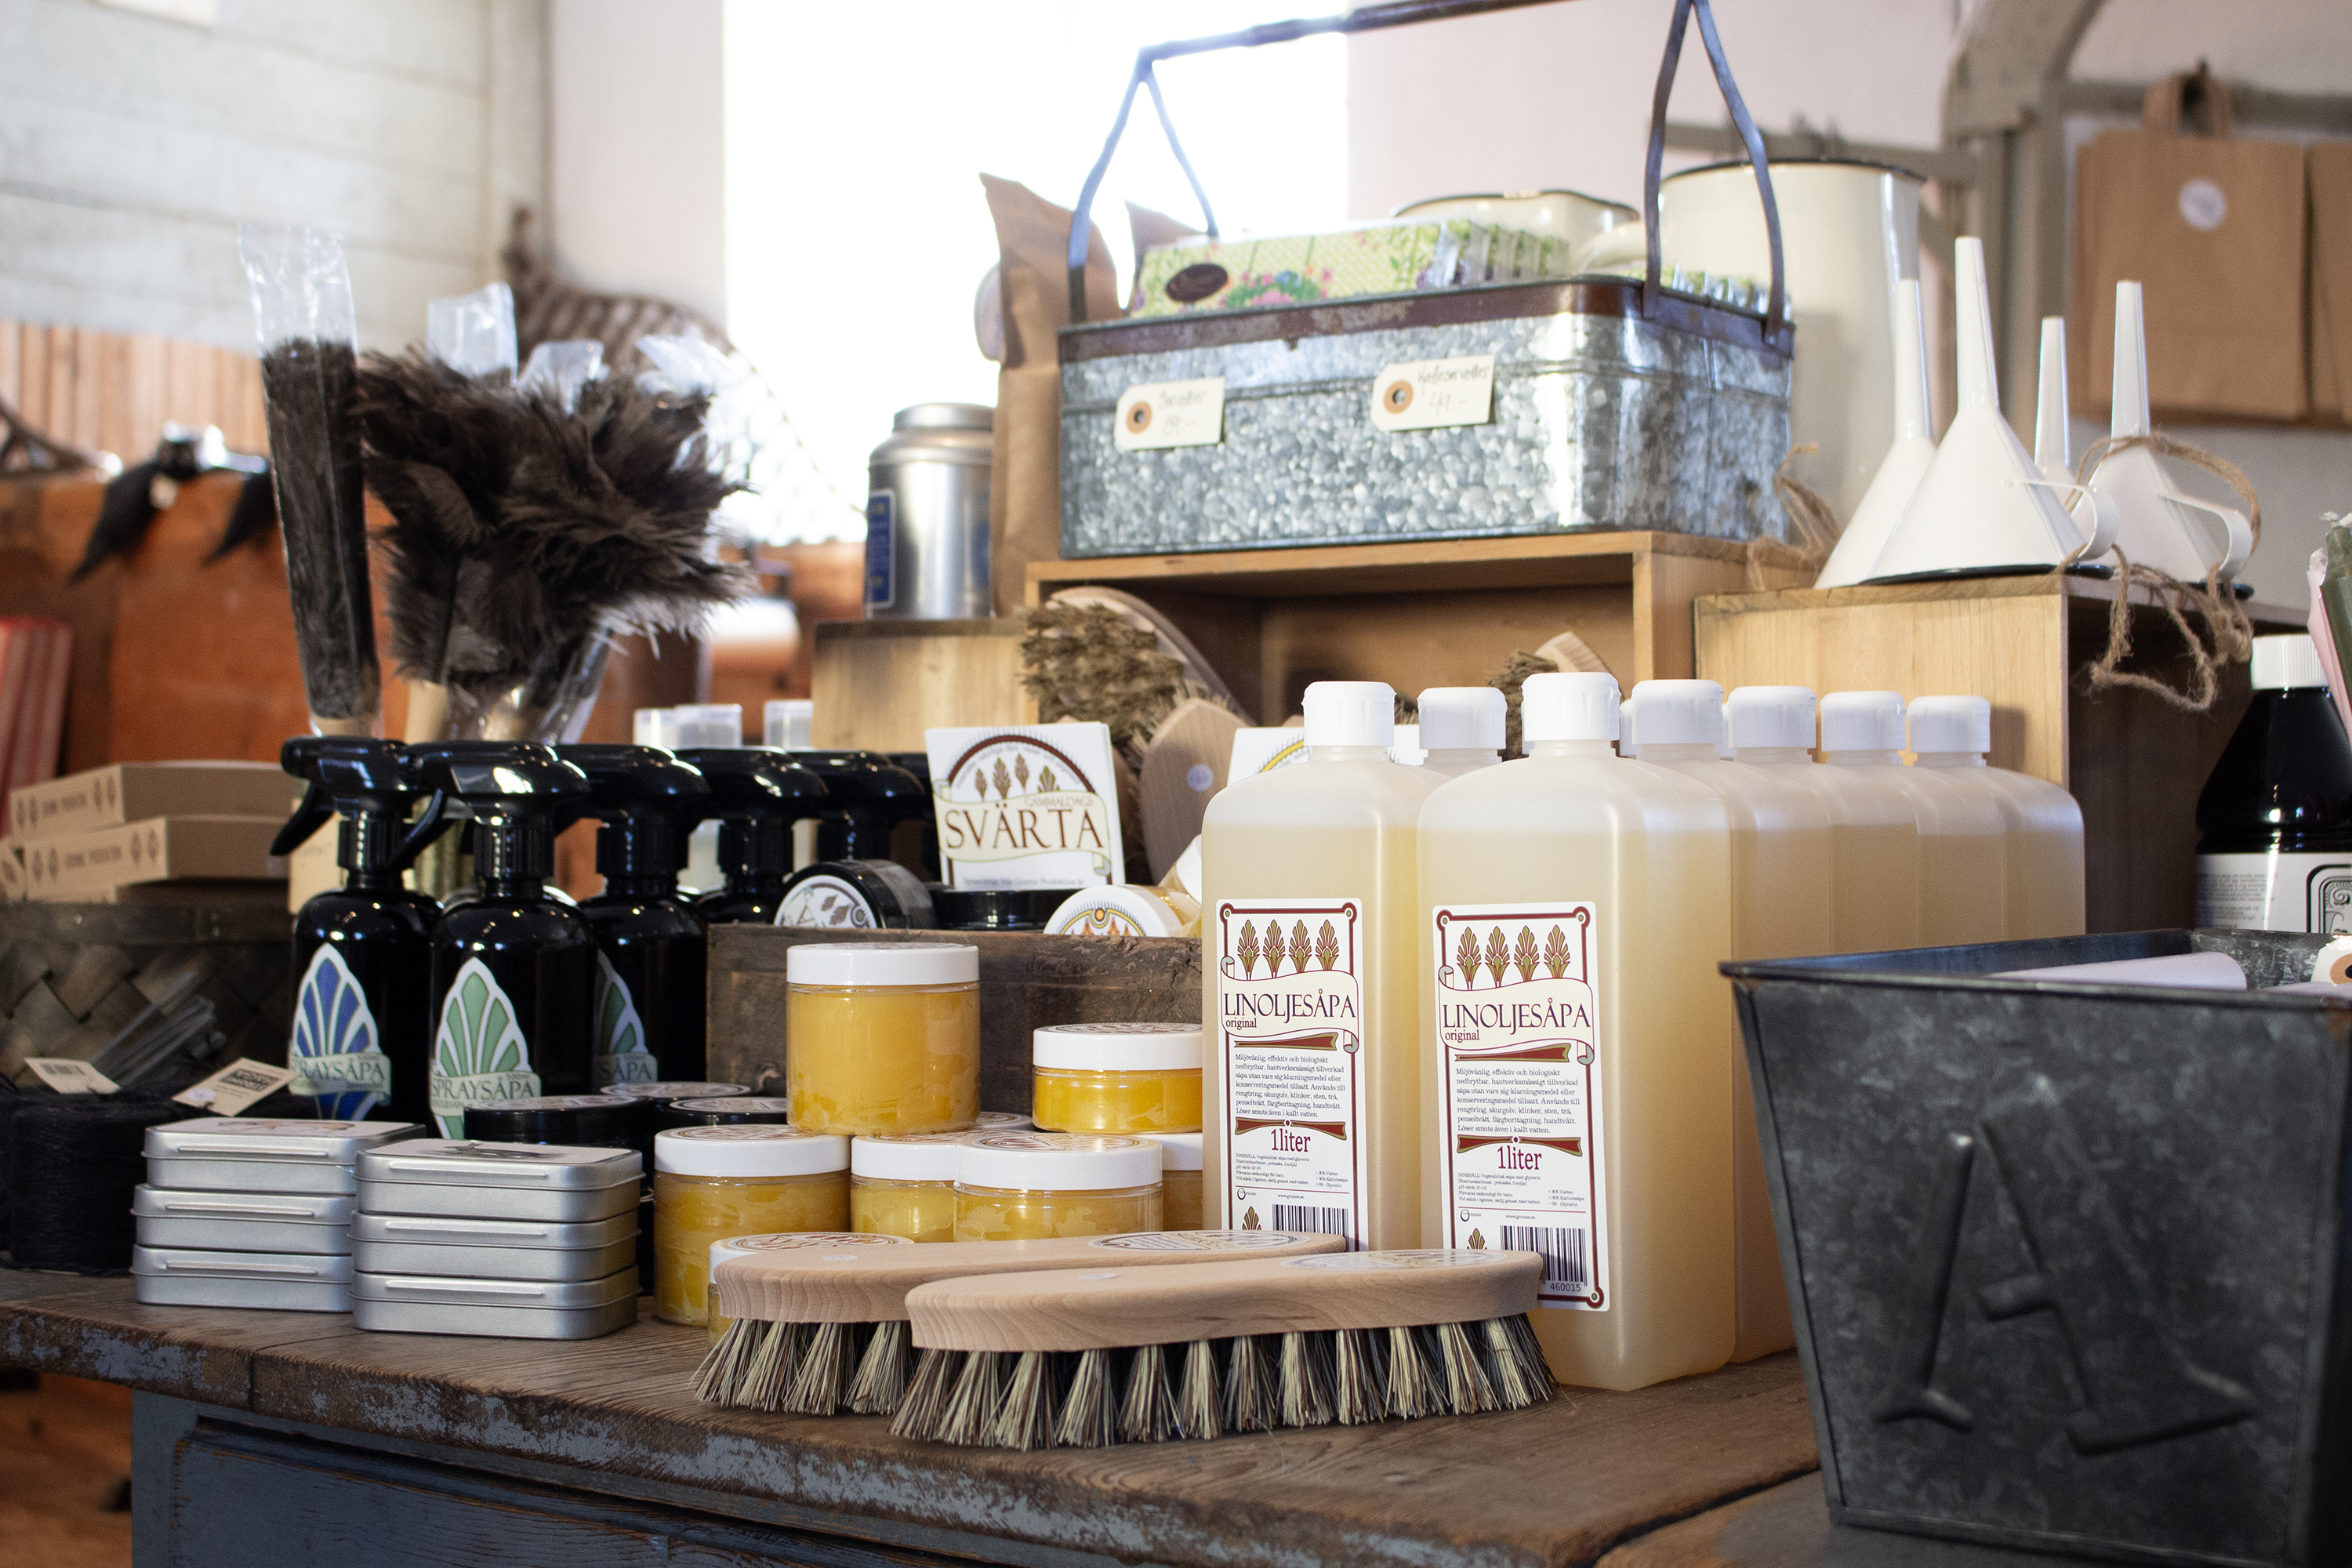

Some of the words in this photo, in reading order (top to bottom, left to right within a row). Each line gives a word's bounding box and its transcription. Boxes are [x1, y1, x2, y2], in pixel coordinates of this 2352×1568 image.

[944, 803, 1105, 849] SVÄRTA
[1224, 989, 1356, 1024] LINOLJESÅPA
[1443, 997, 1591, 1035] LINOLJESÅPA
[1225, 1018, 1257, 1030] original
[1445, 1029, 1480, 1043] original
[432, 1076, 535, 1099] SPRAYSÅPA
[1271, 1128, 1311, 1152] 1liter
[1497, 1145, 1542, 1170] 1liter
[1550, 1283, 1581, 1292] 460015
